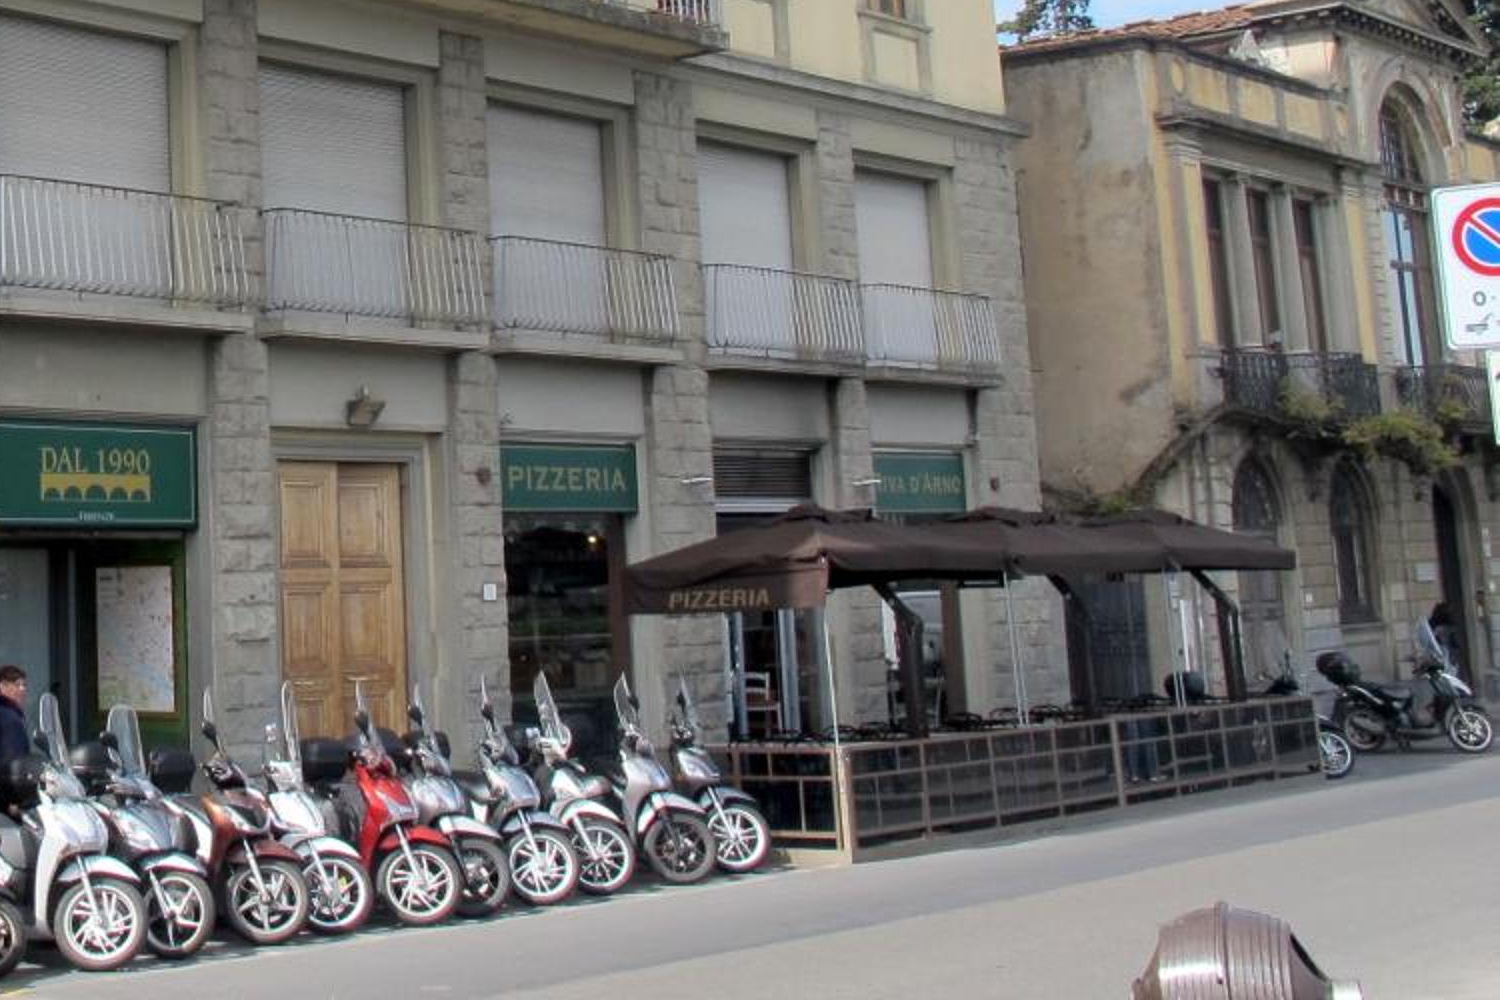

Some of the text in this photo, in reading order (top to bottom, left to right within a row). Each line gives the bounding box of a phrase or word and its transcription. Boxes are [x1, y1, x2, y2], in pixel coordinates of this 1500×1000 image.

[39, 446, 151, 474] DAL 1990
[508, 464, 628, 493] PIZZERIA
[876, 474, 905, 494] IVA
[668, 588, 770, 609] PIZZERIA
